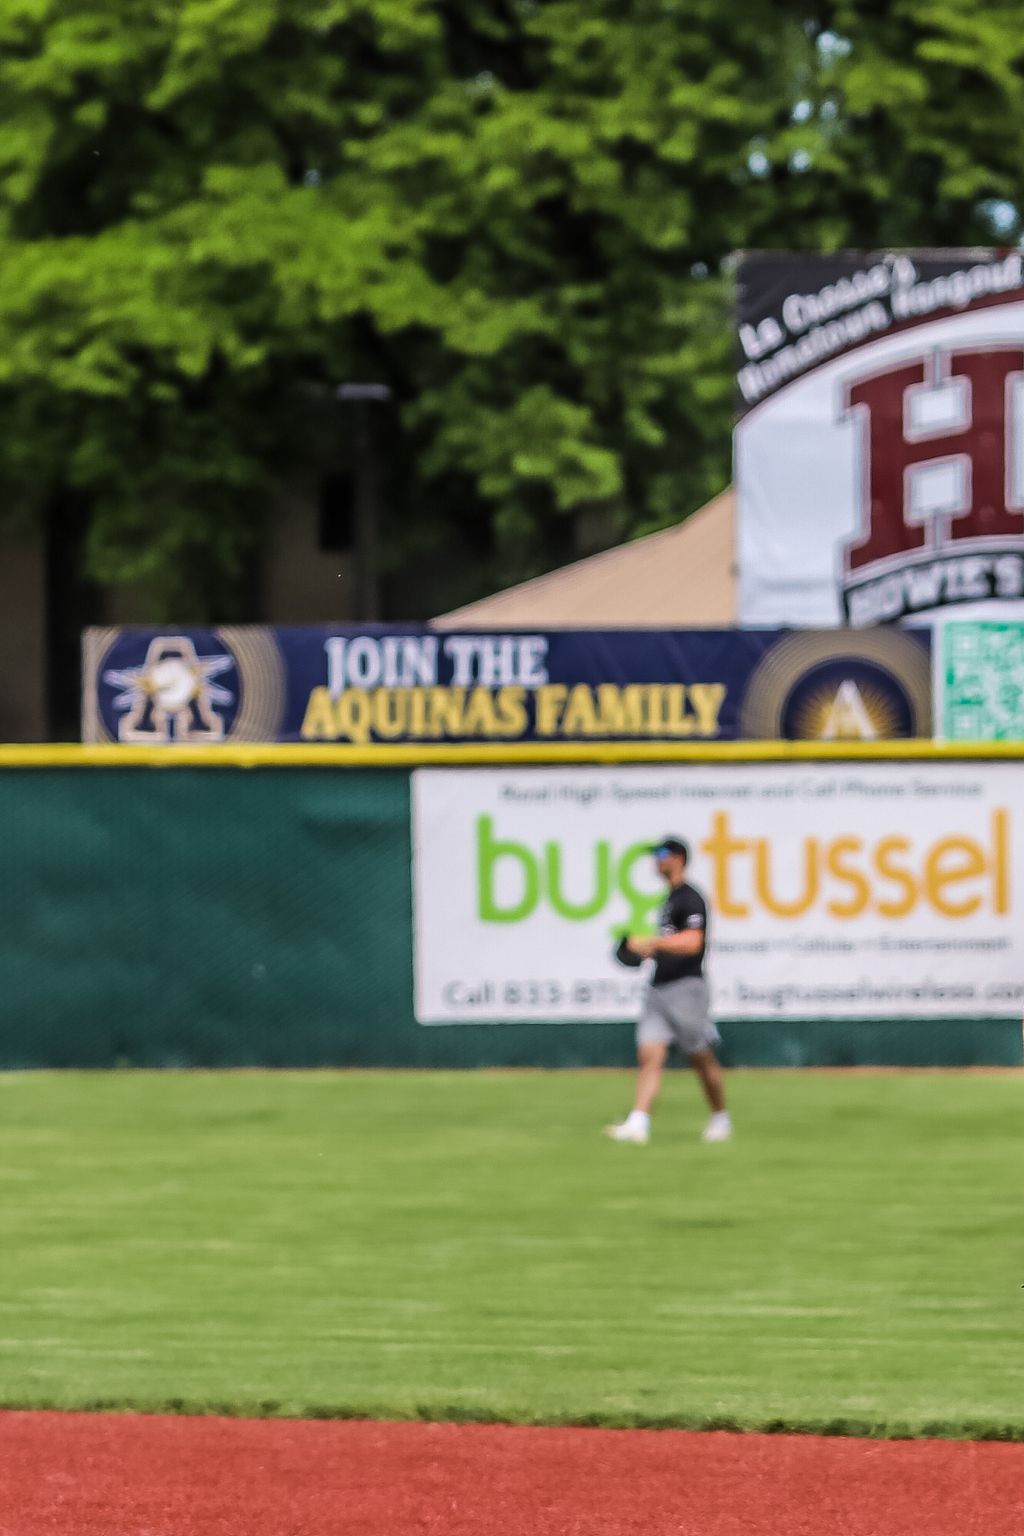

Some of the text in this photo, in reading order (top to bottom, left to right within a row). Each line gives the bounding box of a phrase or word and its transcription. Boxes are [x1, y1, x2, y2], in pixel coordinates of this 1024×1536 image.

[739, 316, 785, 360] La
[325, 636, 549, 698] JOIN THE
[302, 683, 726, 744] AQUINAS FAMILY
[442, 979, 495, 1005] Call
